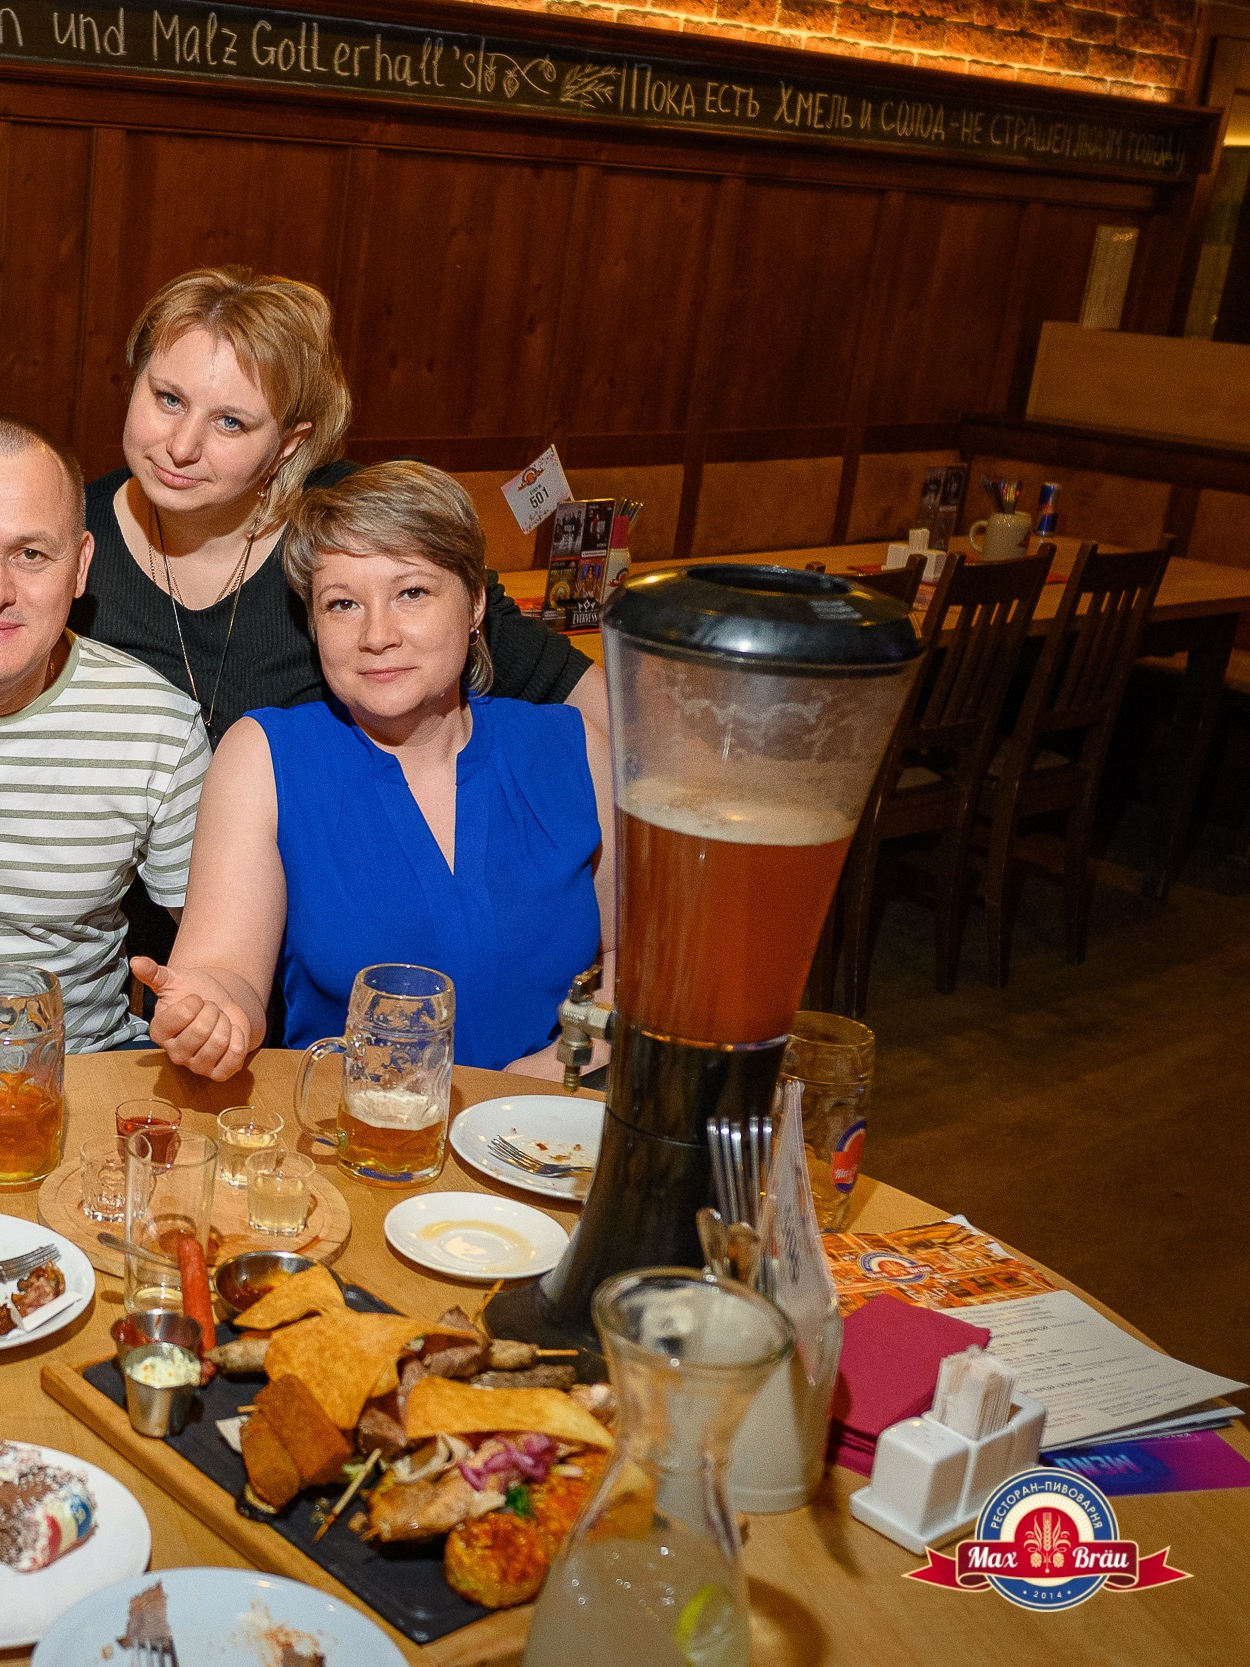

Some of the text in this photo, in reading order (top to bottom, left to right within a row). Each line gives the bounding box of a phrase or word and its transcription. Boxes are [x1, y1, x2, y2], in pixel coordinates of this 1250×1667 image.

[52, 7, 127, 55] und
[152, 9, 238, 66] Malz
[705, 81, 760, 118] ЕСТЬ
[773, 80, 854, 130] ХМЕЛЬ
[860, 99, 873, 132] И
[881, 99, 946, 141] СОЛОД
[529, 487, 550, 509] 501
